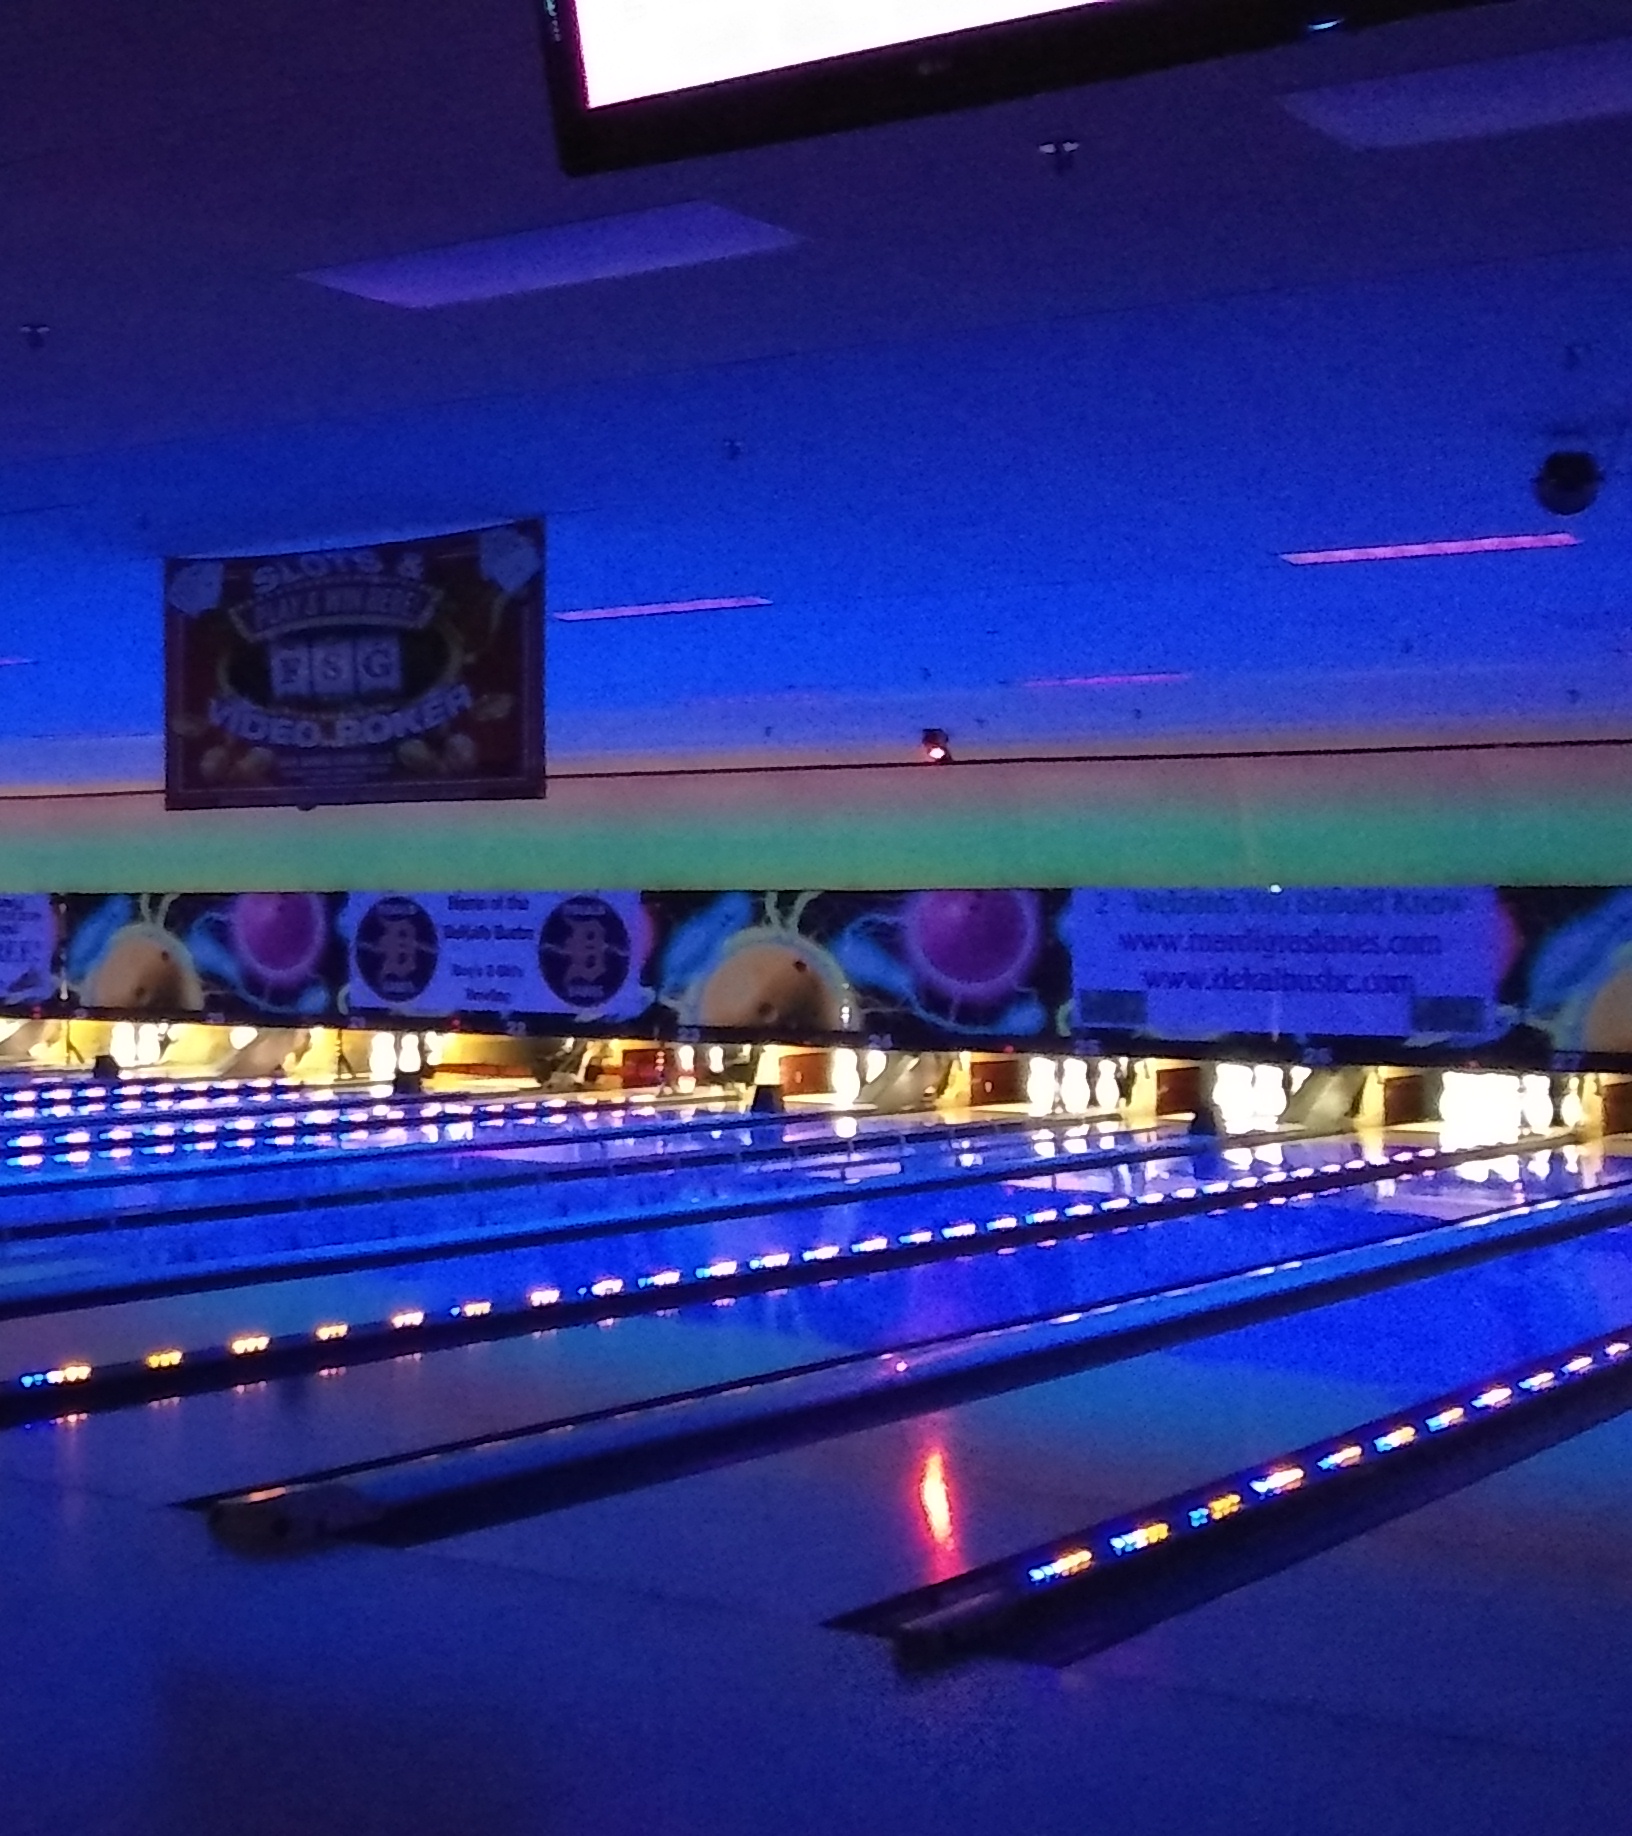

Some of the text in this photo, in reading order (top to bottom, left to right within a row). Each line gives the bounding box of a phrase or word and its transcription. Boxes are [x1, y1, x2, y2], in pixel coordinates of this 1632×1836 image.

[252, 550, 425, 595] SLOTS &
[208, 683, 474, 749] VIDEO POKER
